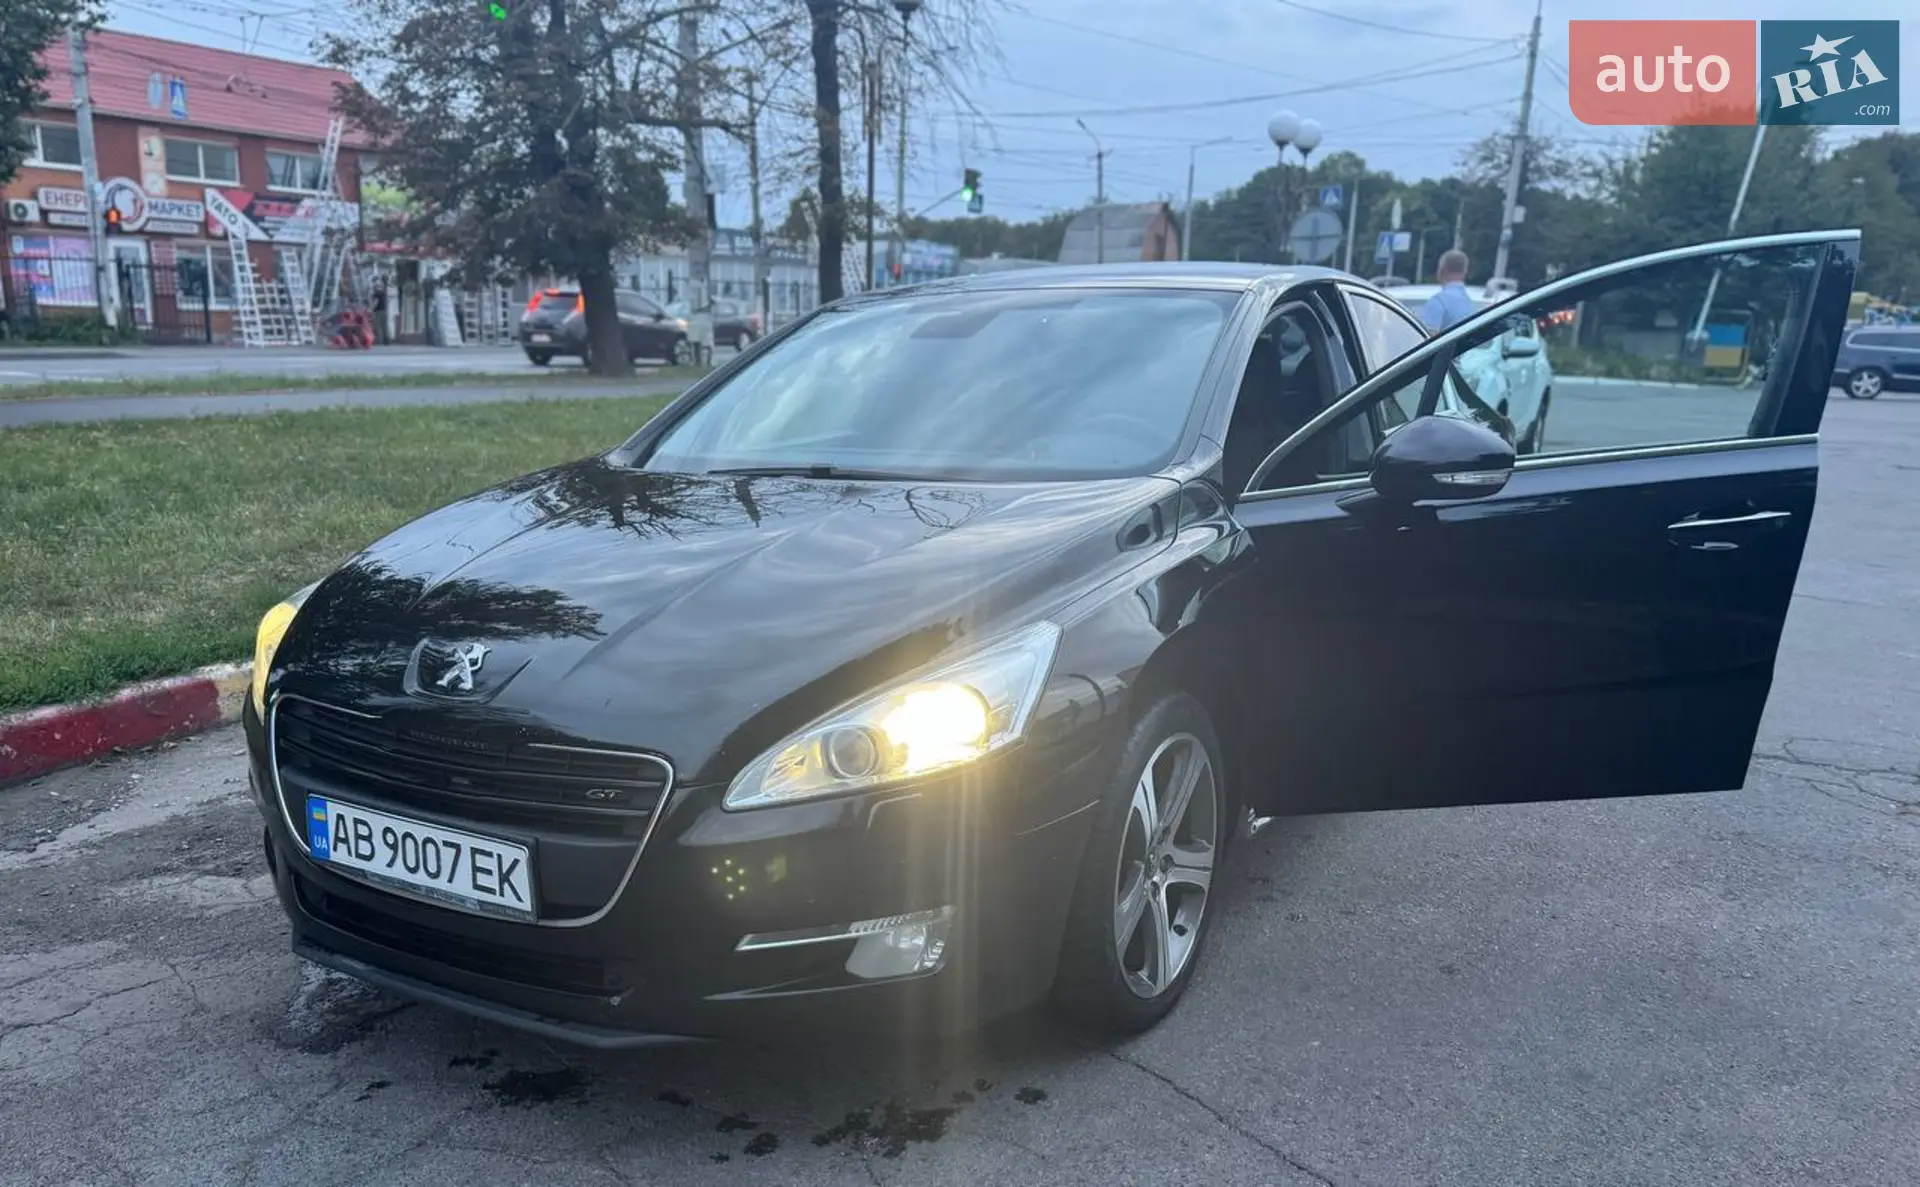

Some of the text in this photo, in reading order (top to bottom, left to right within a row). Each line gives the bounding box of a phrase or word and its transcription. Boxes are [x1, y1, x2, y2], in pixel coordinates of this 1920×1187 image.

[211, 195, 238, 225] YATO
[584, 788, 624, 800] GT
[314, 835, 328, 851] UA
[332, 813, 376, 862] AB
[382, 826, 462, 884] 9007
[469, 846, 524, 903] EK
